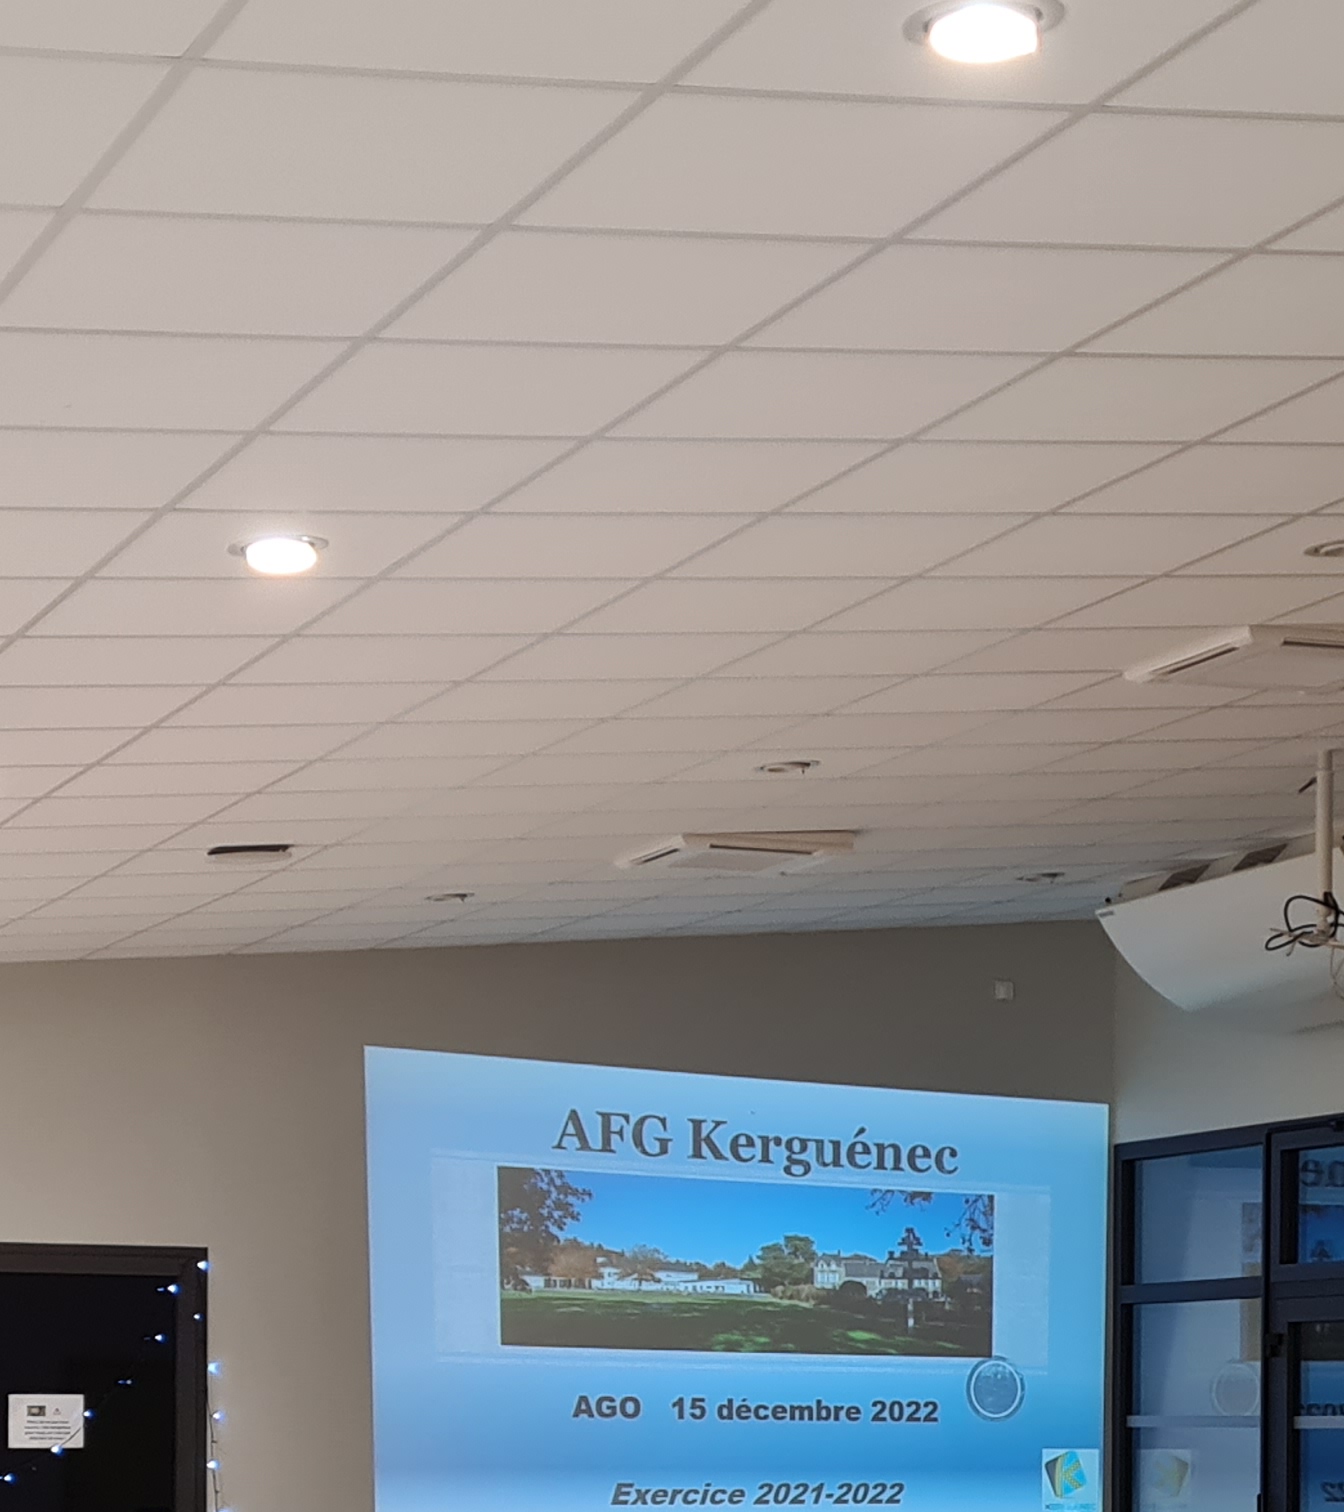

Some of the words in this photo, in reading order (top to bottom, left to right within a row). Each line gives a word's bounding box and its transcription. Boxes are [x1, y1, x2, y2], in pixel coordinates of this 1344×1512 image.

[552, 1108, 673, 1157] AFG
[687, 1117, 959, 1178] Kerguénec
[572, 1395, 642, 1419] AGO
[671, 1397, 706, 1421] 15
[717, 1398, 862, 1422] décembre
[871, 1400, 939, 1423] 2022
[610, 1482, 746, 1506] Exercice
[753, 1482, 905, 1506] 2021-2022
